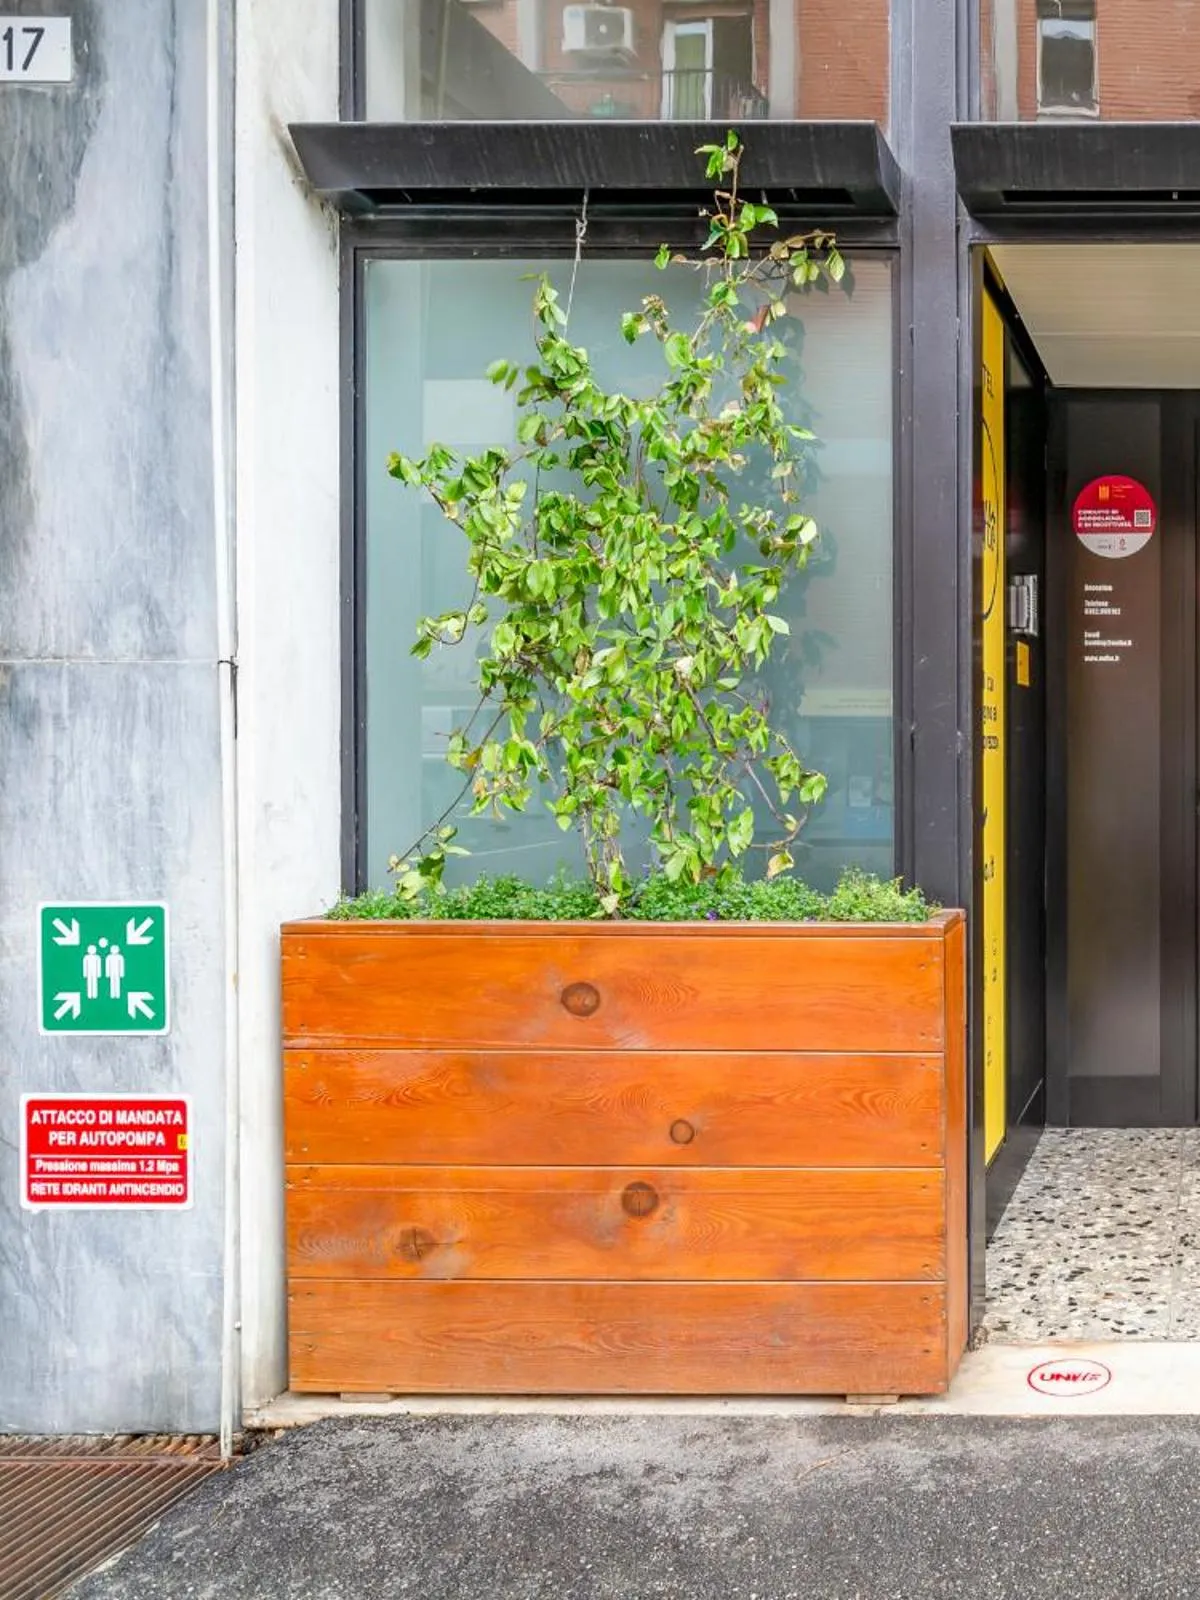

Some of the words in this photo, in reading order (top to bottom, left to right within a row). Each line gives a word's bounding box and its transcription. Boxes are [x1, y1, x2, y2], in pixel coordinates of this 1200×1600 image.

[2, 26, 45, 71] 17
[31, 1110, 97, 1125] ATTACCO
[99, 1110, 113, 1125] DI
[116, 1110, 183, 1125] MANDATA
[48, 1131, 77, 1146] PER
[79, 1131, 166, 1146] AUTOPOMPA
[35, 1159, 88, 1173] Pressione
[31, 1182, 60, 1196] RETE
[62, 1183, 107, 1196] IDRANTI
[109, 1183, 185, 1197] ANTINCENDIO
